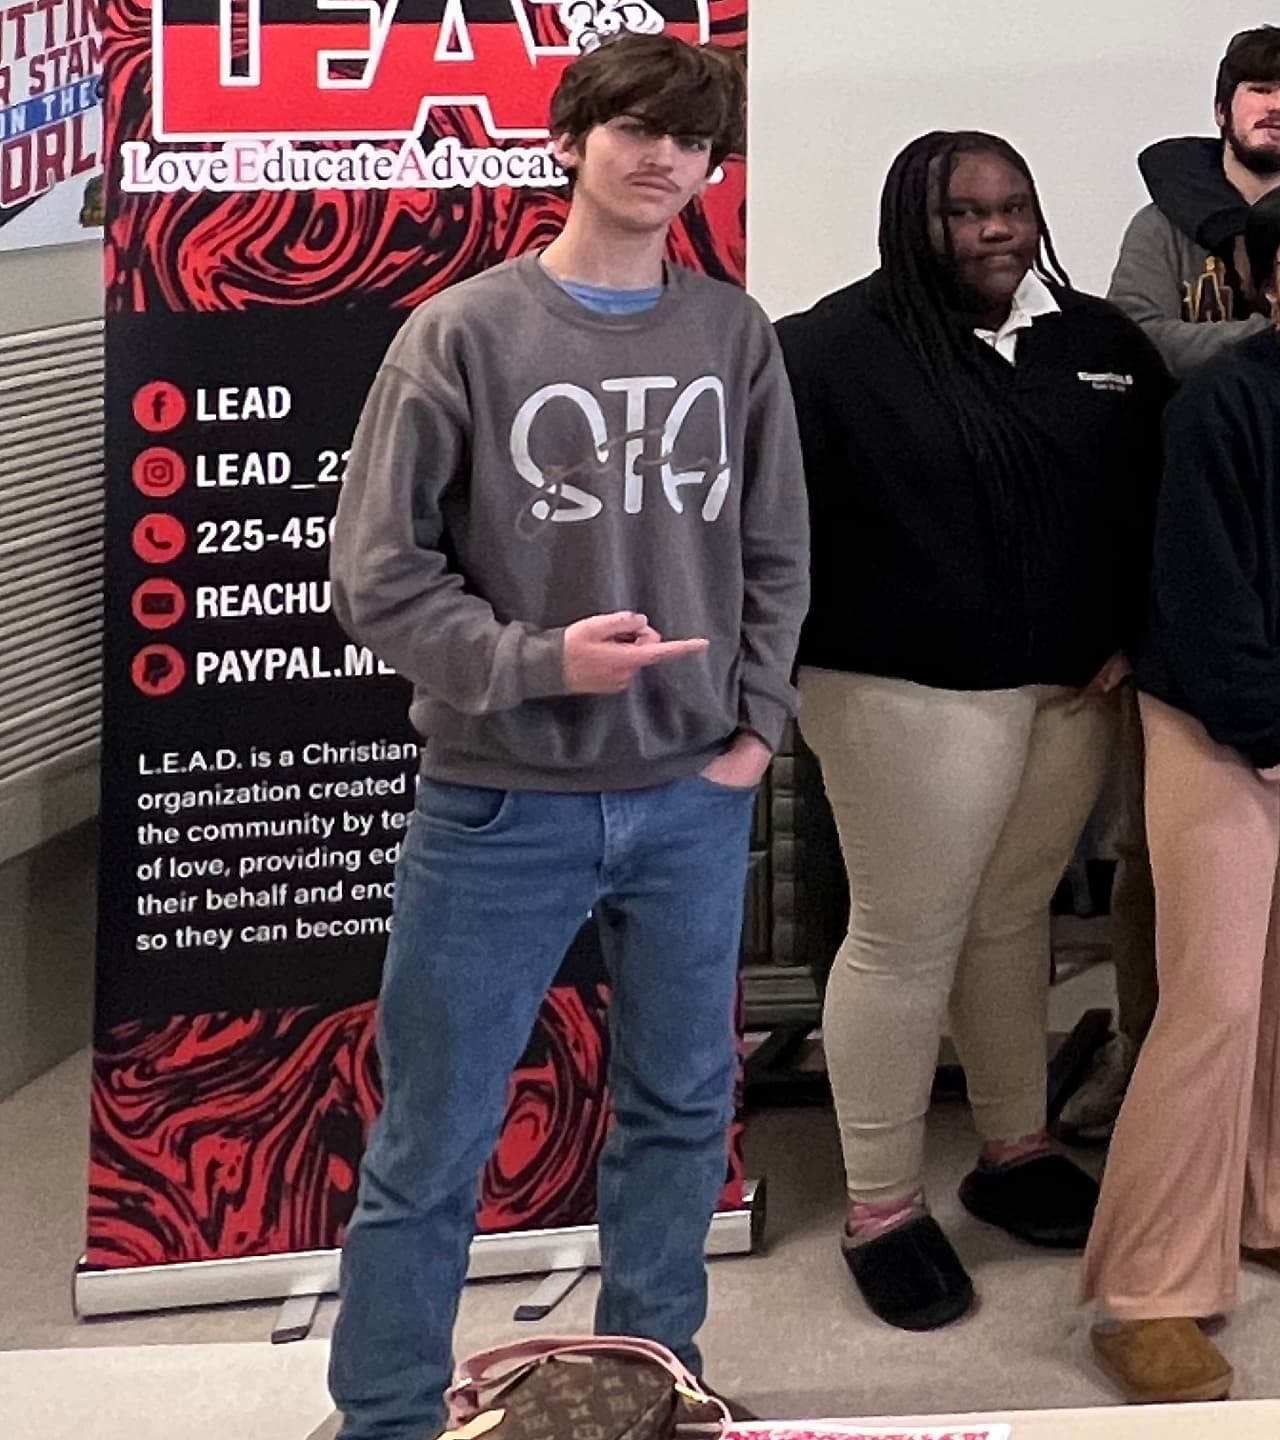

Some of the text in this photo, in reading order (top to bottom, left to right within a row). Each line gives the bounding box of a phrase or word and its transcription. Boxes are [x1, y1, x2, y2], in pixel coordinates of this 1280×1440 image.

[196, 386, 291, 421] LEAD
[139, 749, 242, 775] L.E.A.D.
[250, 747, 271, 768] is
[279, 750, 294, 768] a
[138, 779, 301, 814] organization
[309, 773, 406, 801] created
[138, 823, 179, 845] the
[187, 814, 335, 843] community
[343, 810, 373, 835] by
[136, 857, 162, 881] of
[170, 857, 231, 879] love,
[239, 846, 361, 879] providing
[137, 891, 198, 916] their
[206, 883, 289, 911] behalf
[294, 881, 343, 905] and
[136, 931, 167, 952] so
[175, 924, 233, 950] they
[240, 922, 287, 944] can
